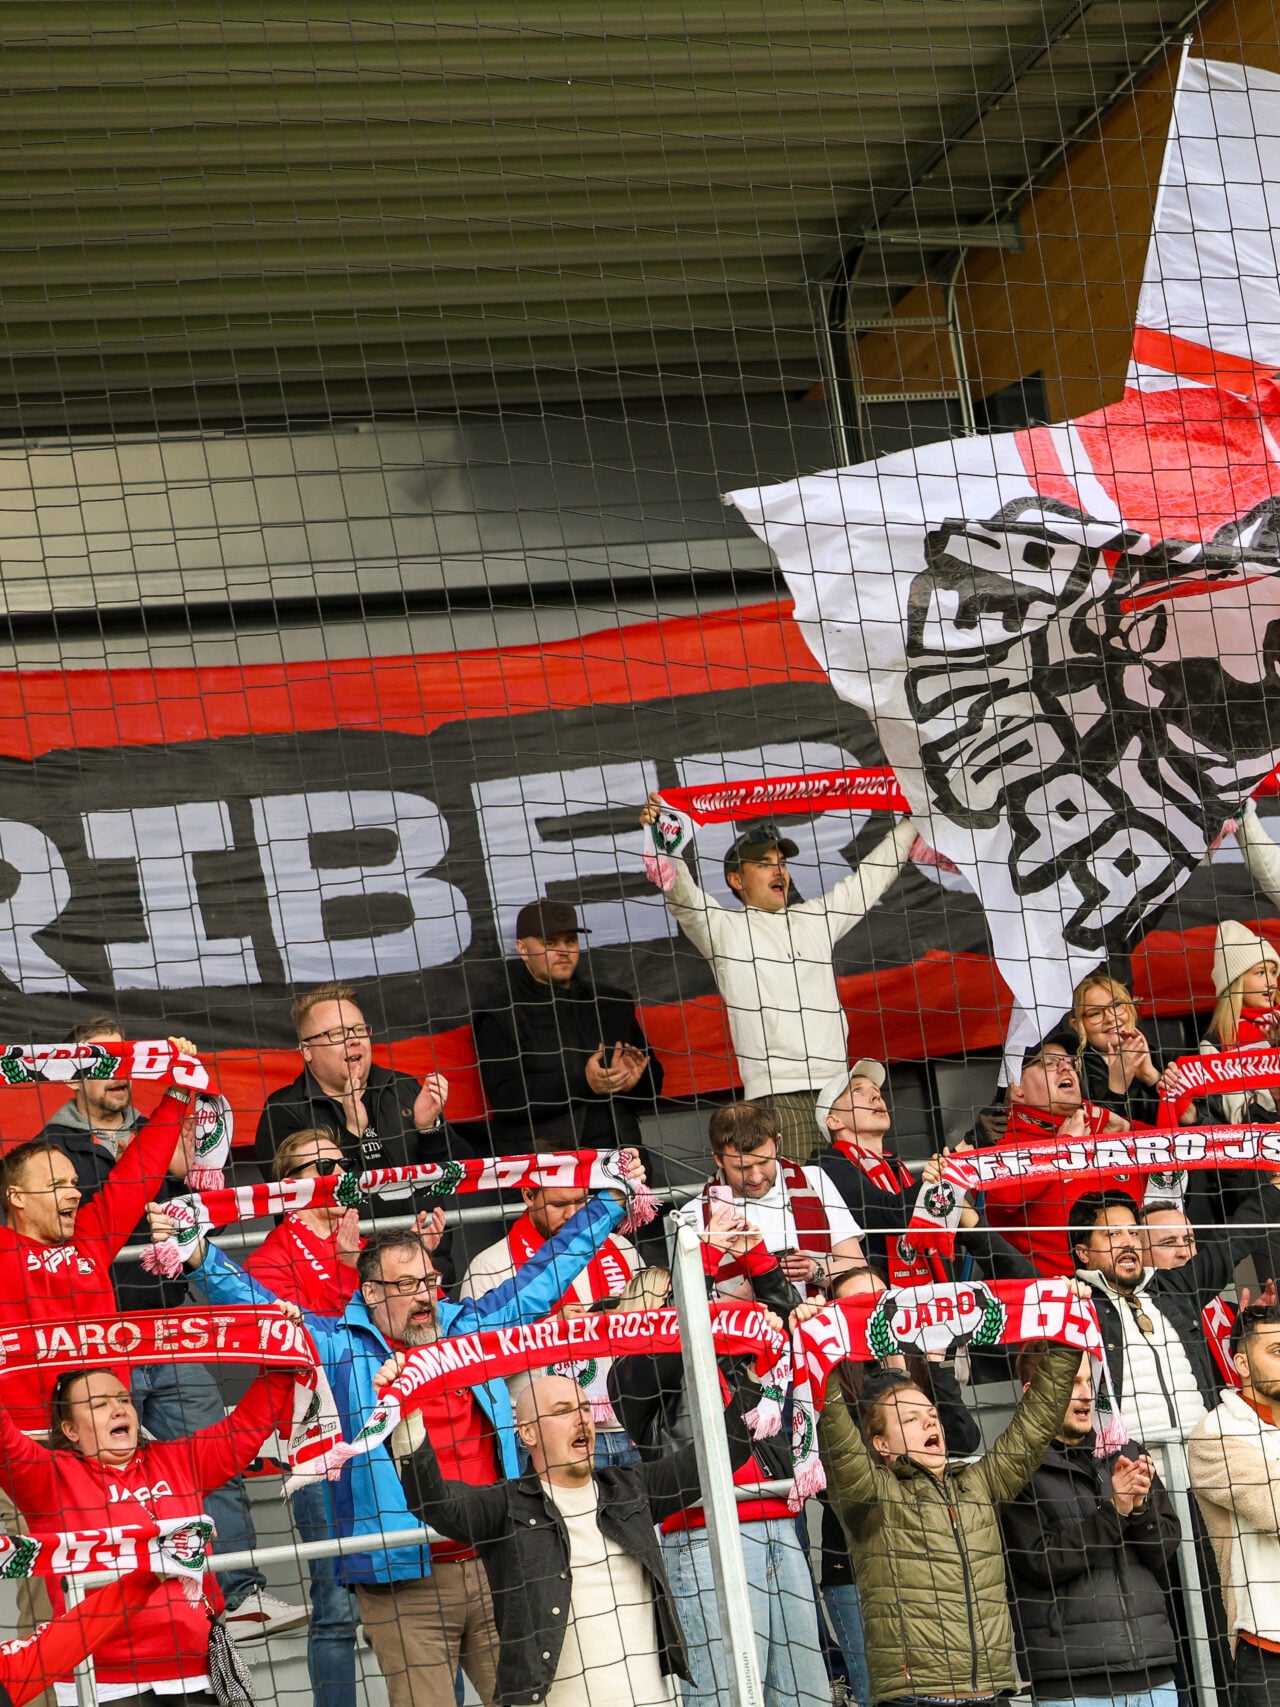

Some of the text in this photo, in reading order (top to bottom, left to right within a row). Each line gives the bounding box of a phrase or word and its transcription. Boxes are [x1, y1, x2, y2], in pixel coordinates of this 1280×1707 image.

[692, 788, 740, 814] VANHA
[847, 775, 905, 796] RUOST
[659, 819, 681, 836] ARO
[131, 1040, 209, 1090] 65
[194, 1109, 216, 1125] ARO
[965, 1151, 1033, 1181] FF
[1051, 1132, 1206, 1171] JARO
[35, 1320, 141, 1360] JARO
[154, 1316, 240, 1351] EST.
[896, 1290, 976, 1335] JARO
[1020, 1279, 1101, 1354] 65
[398, 1333, 496, 1397] GAMMAL
[607, 1309, 680, 1340] ROSTA
[51, 1523, 144, 1575] 65
